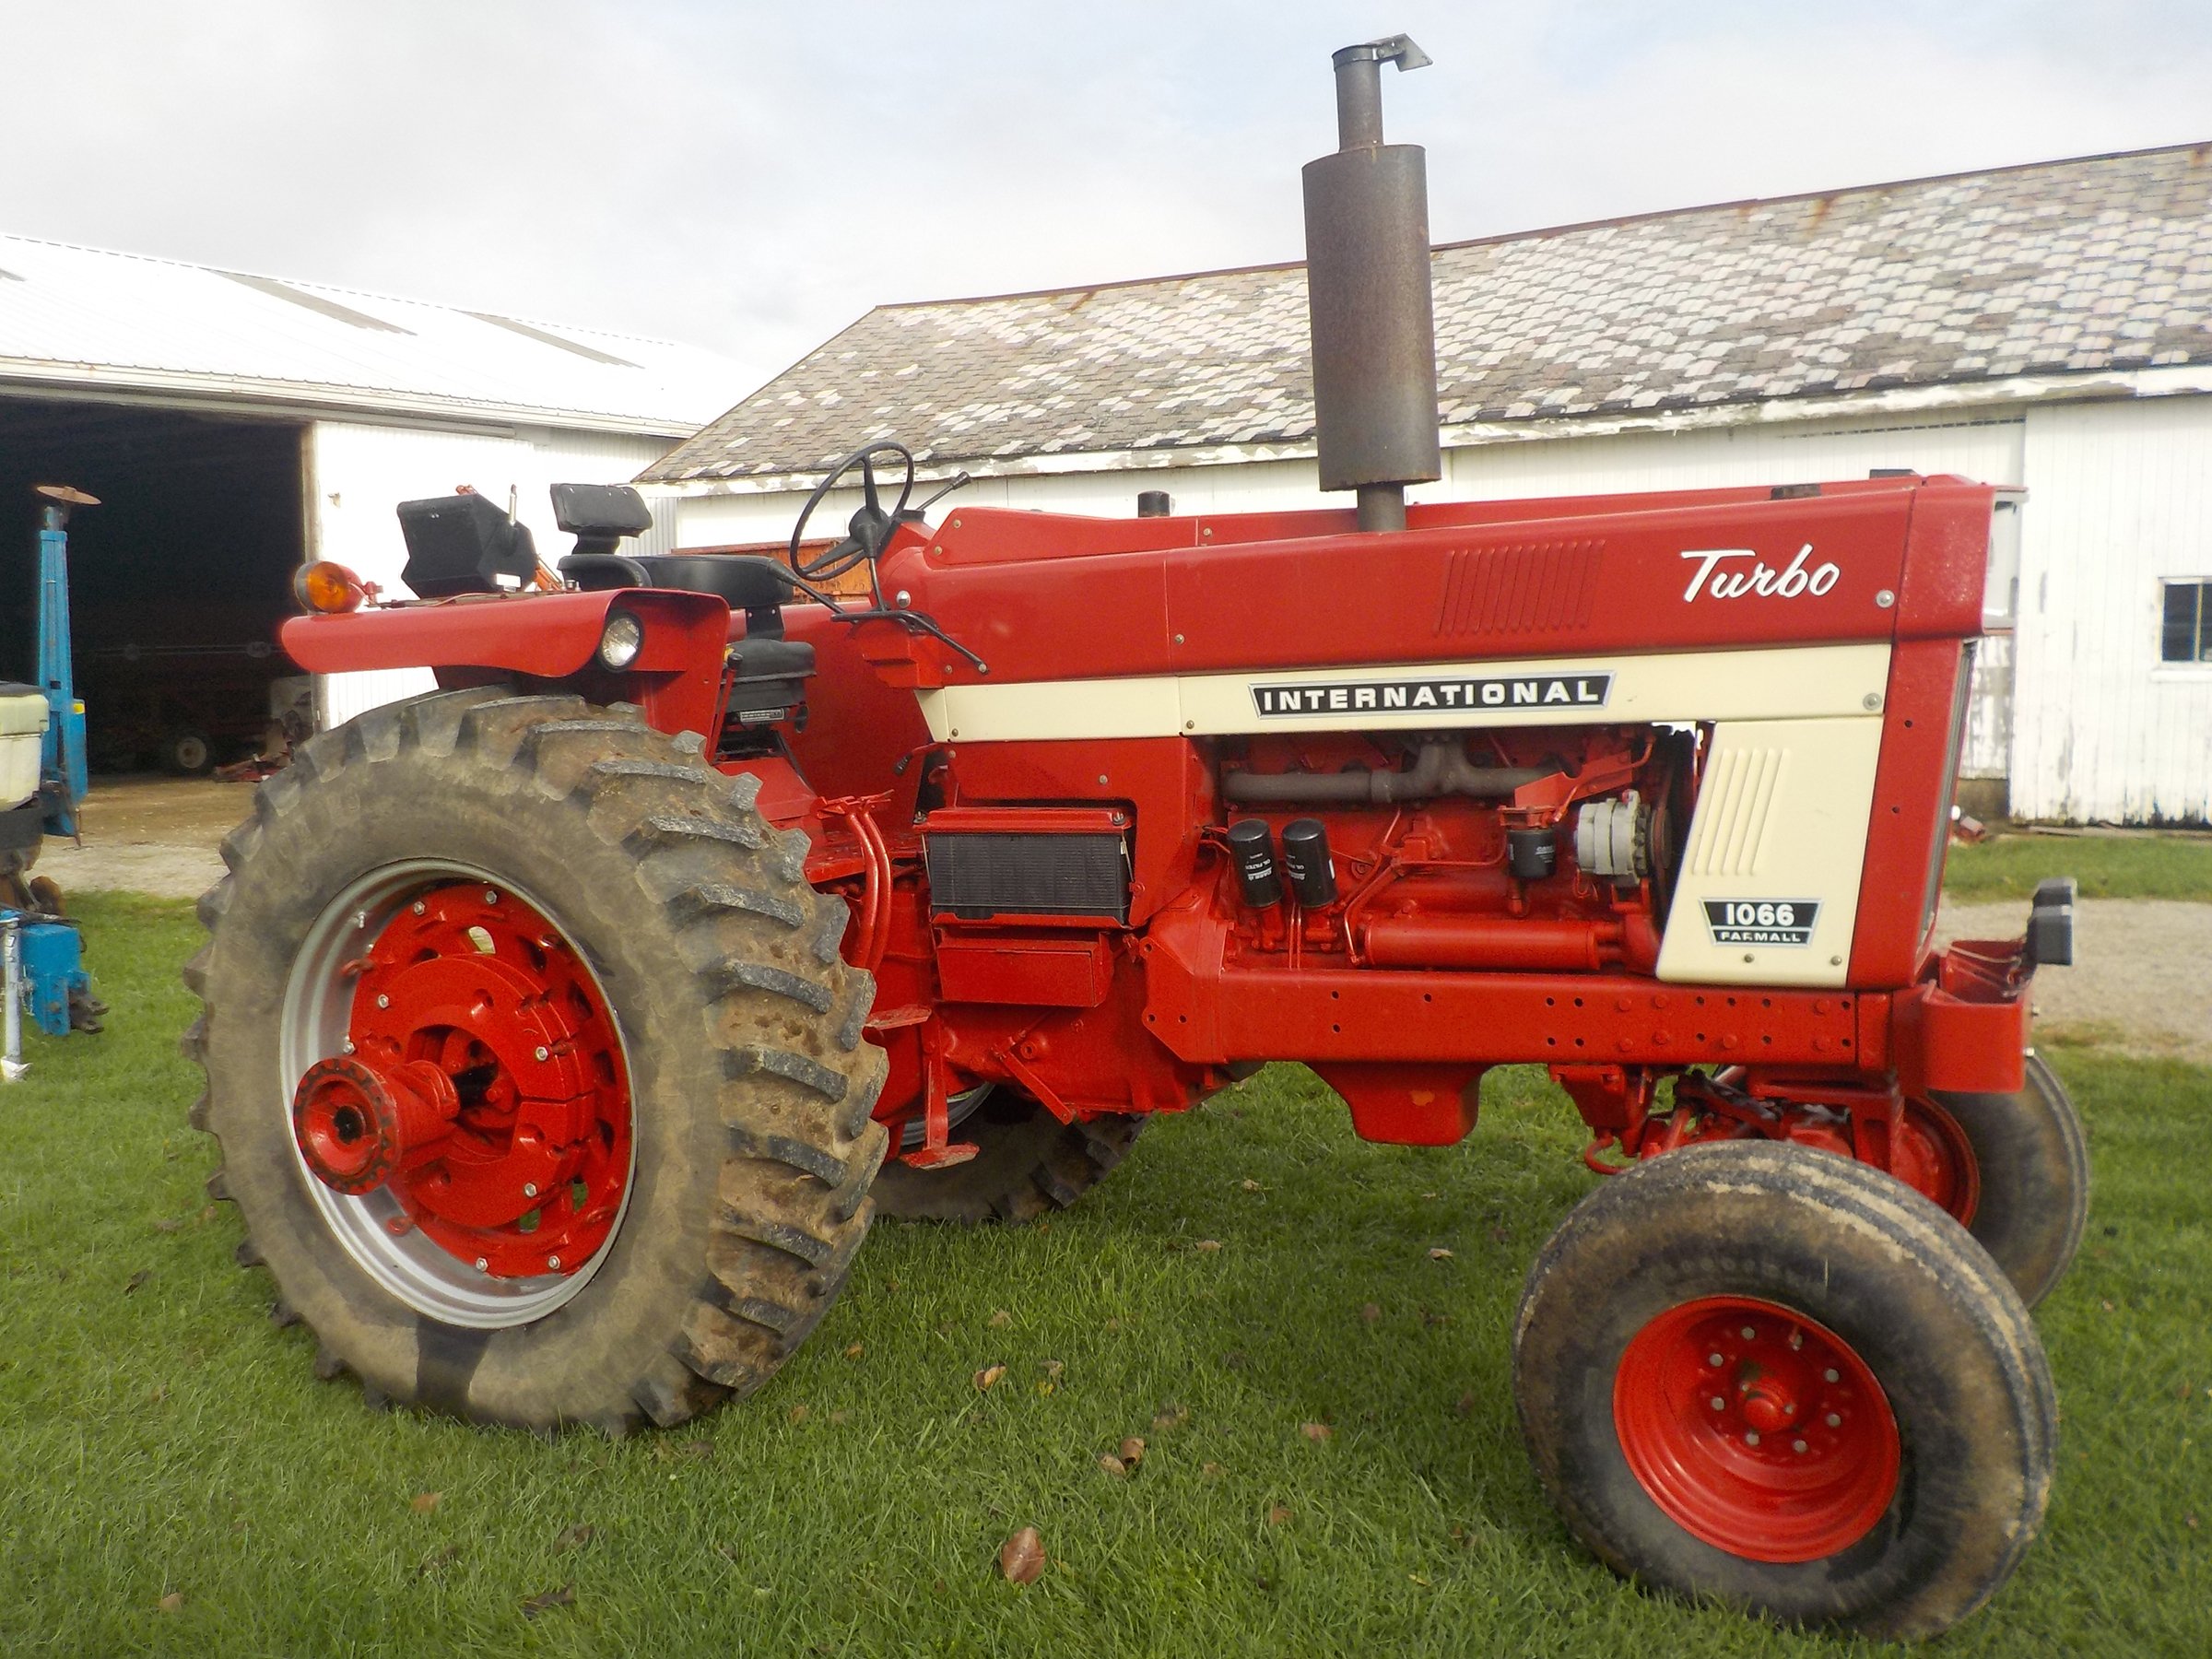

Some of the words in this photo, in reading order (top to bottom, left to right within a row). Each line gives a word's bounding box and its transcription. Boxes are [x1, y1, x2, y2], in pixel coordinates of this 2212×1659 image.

[1681, 542, 1841, 603] Turbo
[1263, 680, 1599, 712] INTERNATIONAL
[1725, 903, 1795, 926] 1066
[1721, 931, 1801, 943] FARMALL
